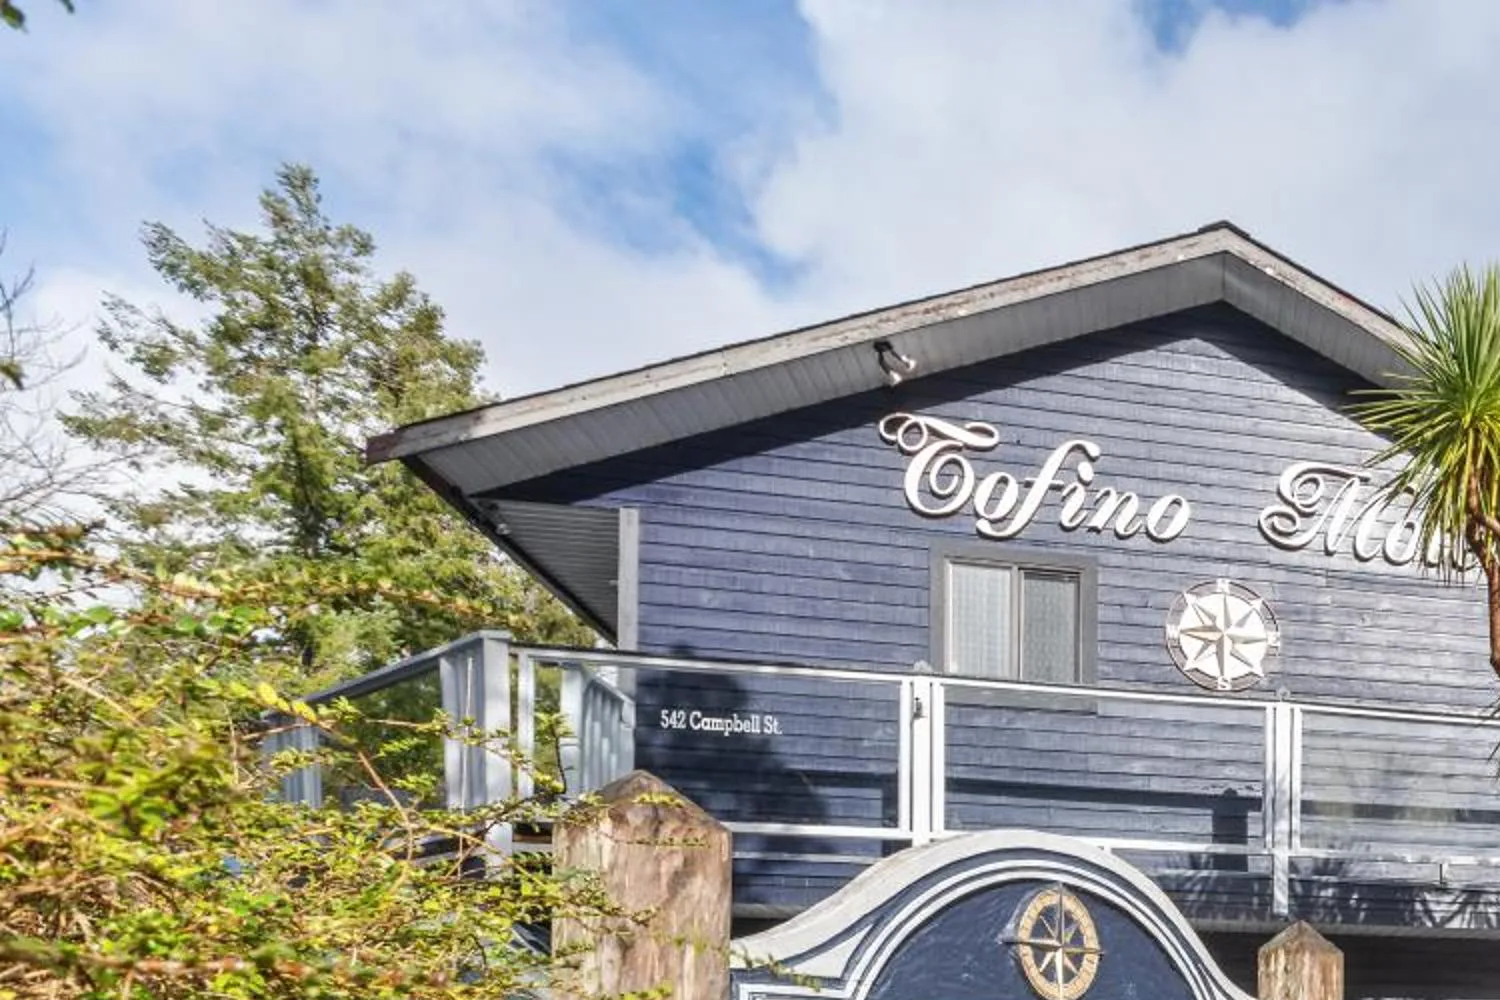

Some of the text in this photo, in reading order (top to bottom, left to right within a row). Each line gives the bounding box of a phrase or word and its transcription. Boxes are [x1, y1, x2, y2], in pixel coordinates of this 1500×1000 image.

[879, 412, 1191, 540] Tofino
[1218, 676, 1231, 690] S
[660, 709, 783, 736] 542 Campbell St.
